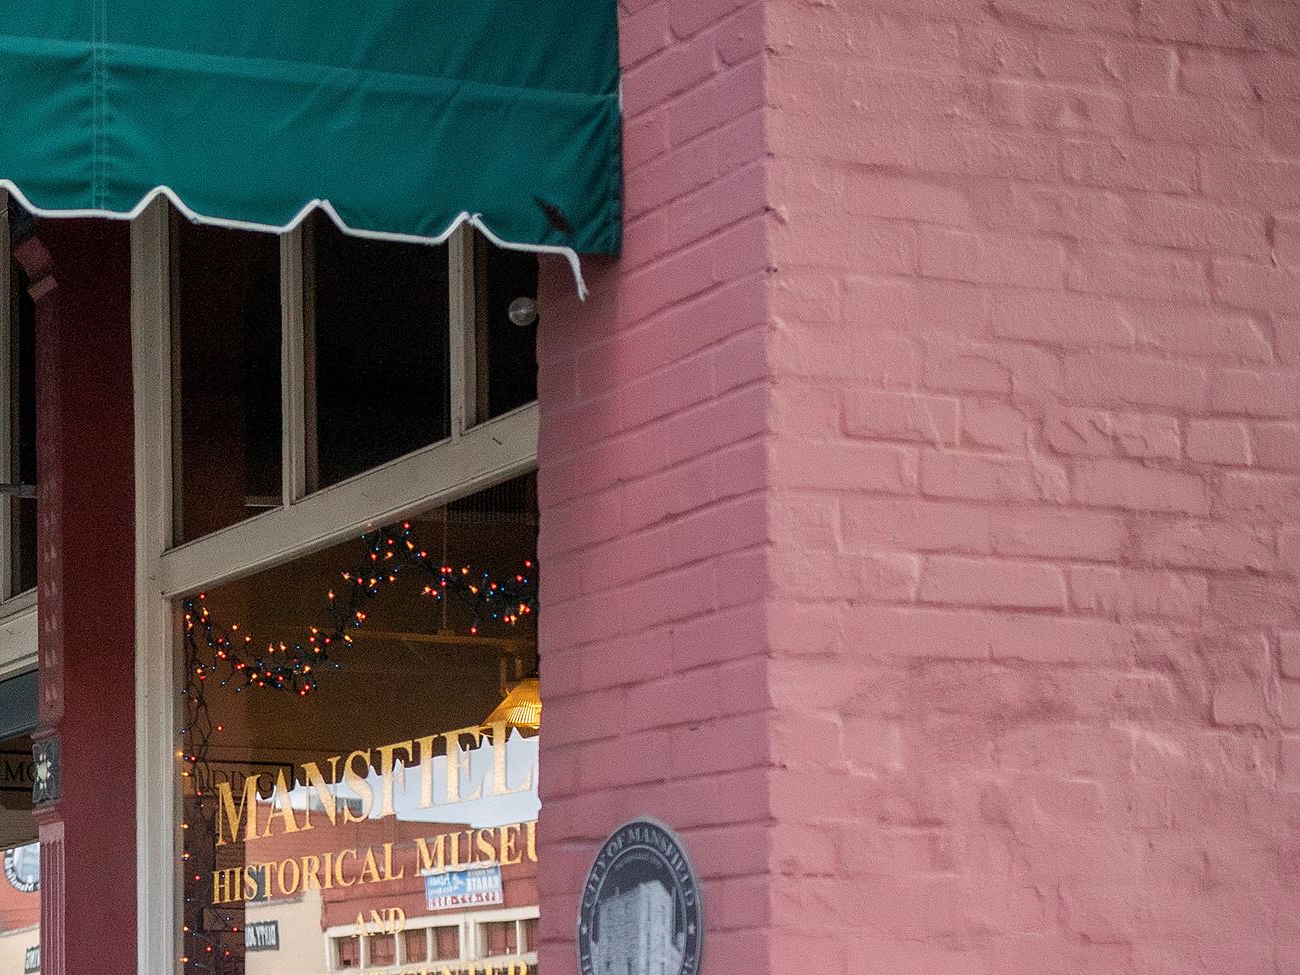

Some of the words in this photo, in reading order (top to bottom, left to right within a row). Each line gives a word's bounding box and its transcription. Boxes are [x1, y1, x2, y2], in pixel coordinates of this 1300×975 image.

[215, 720, 536, 847] MANSFIEL
[212, 841, 405, 905] HISTORICAL
[584, 855, 607, 909] CITY
[606, 833, 626, 857] OF
[627, 827, 696, 907] MANSFIELD
[351, 907, 407, 938] AND
